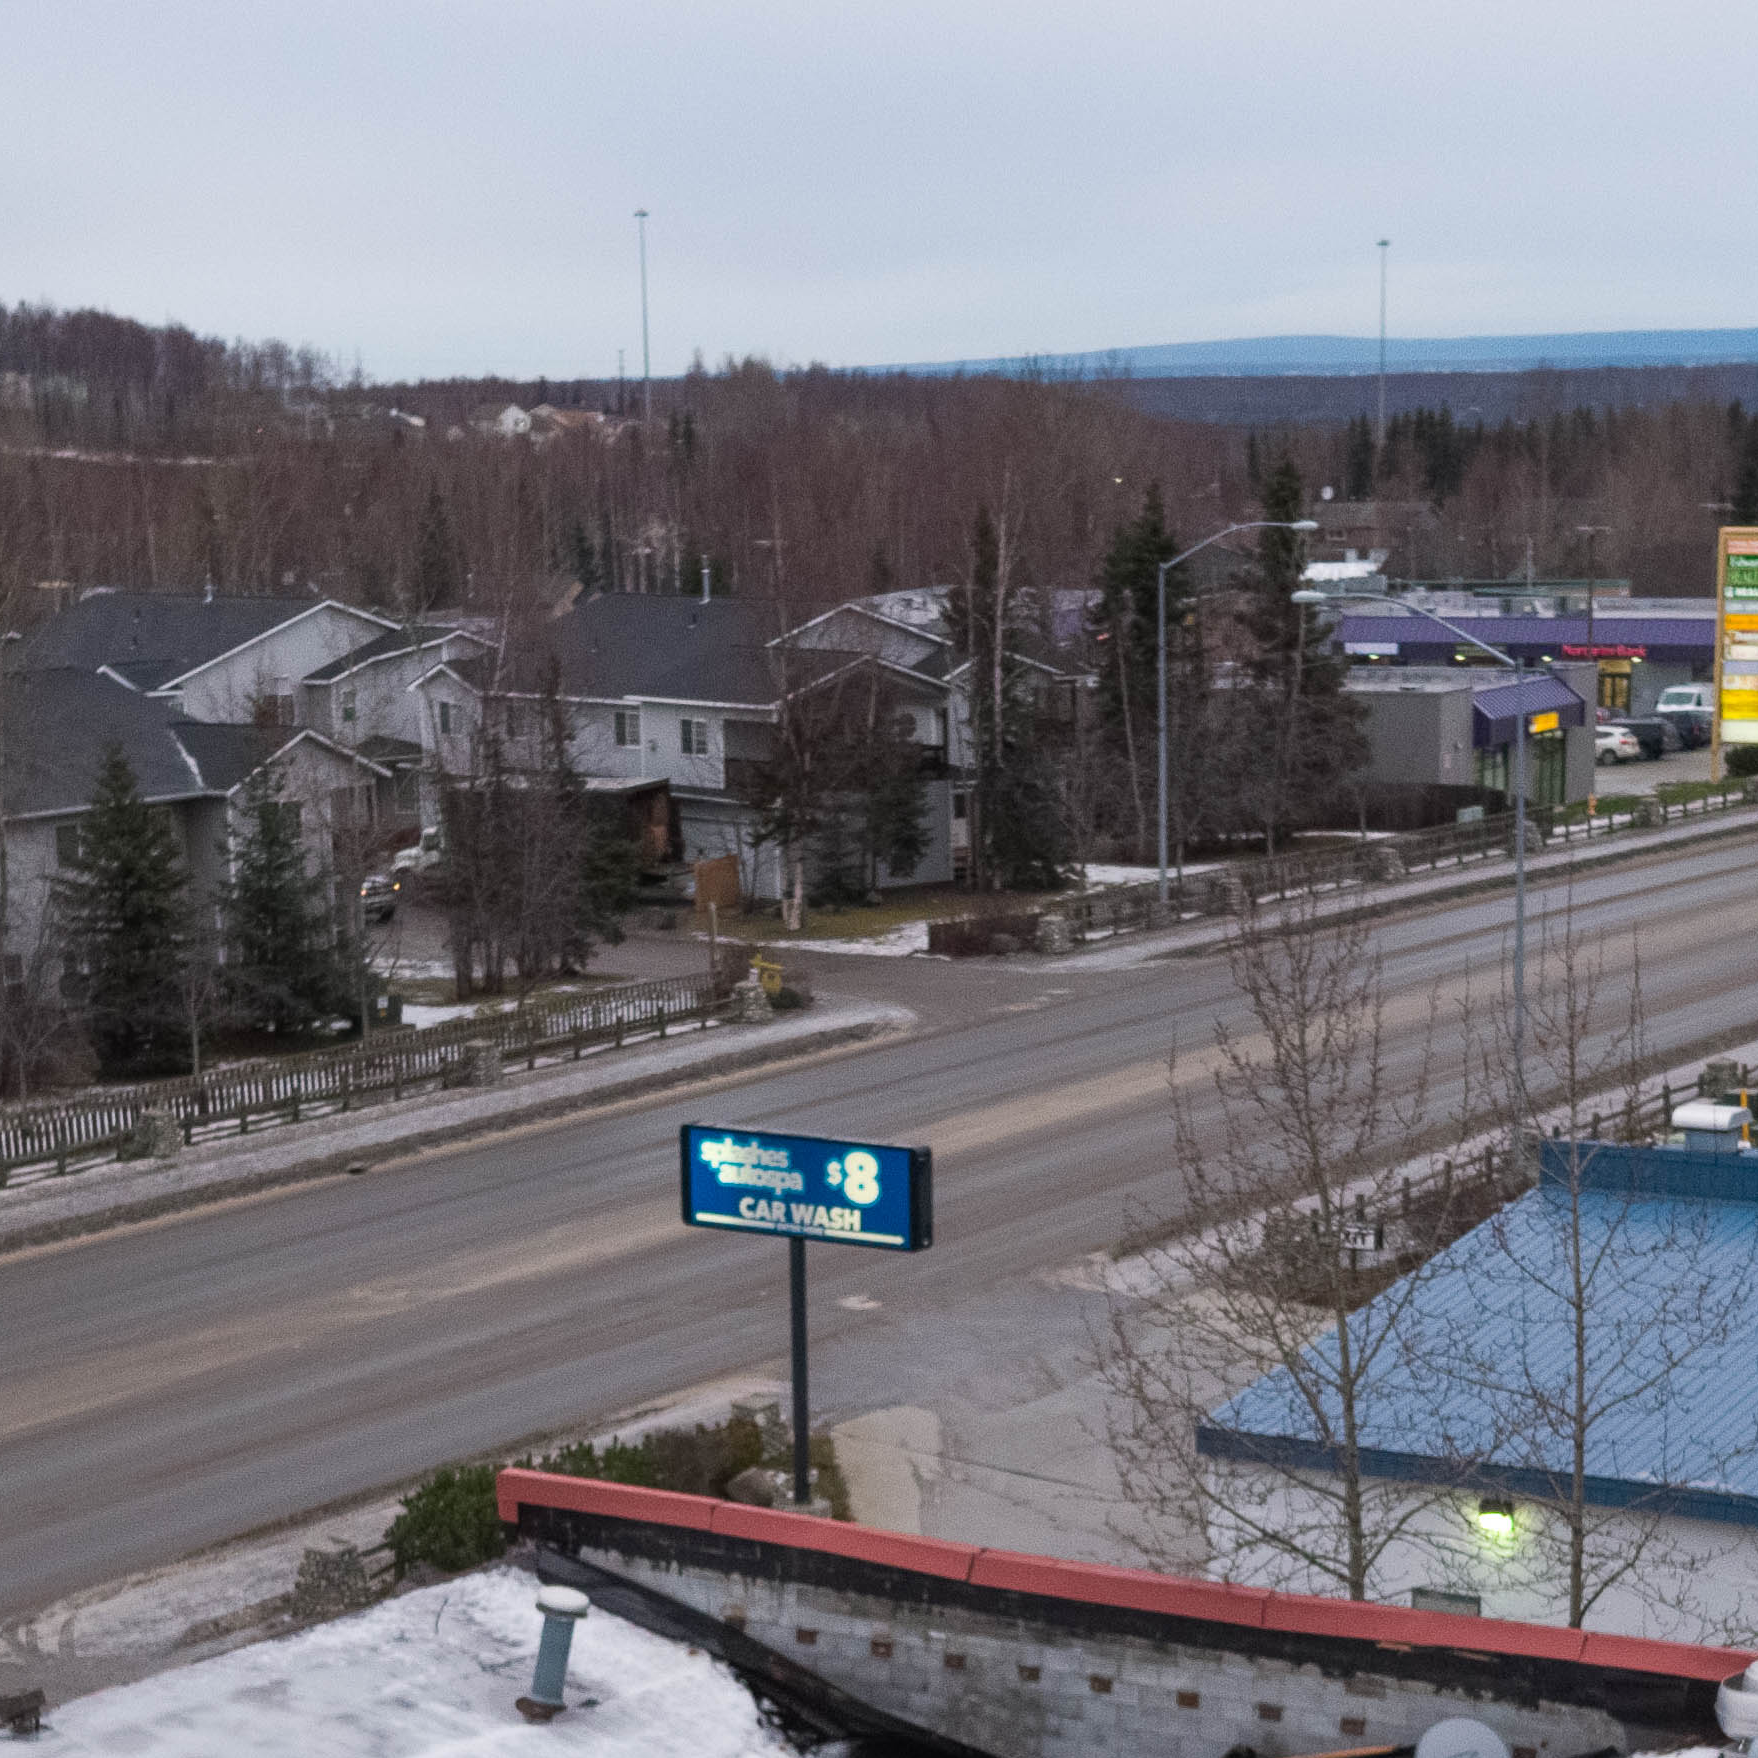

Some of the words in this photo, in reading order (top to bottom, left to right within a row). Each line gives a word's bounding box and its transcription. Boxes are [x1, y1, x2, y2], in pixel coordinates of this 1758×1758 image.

[700, 1137, 789, 1169] splashes
[718, 1163, 803, 1195] autospa
[827, 1151, 879, 1204] $8
[739, 1197, 786, 1222] CAR
[790, 1203, 861, 1232] WASH
